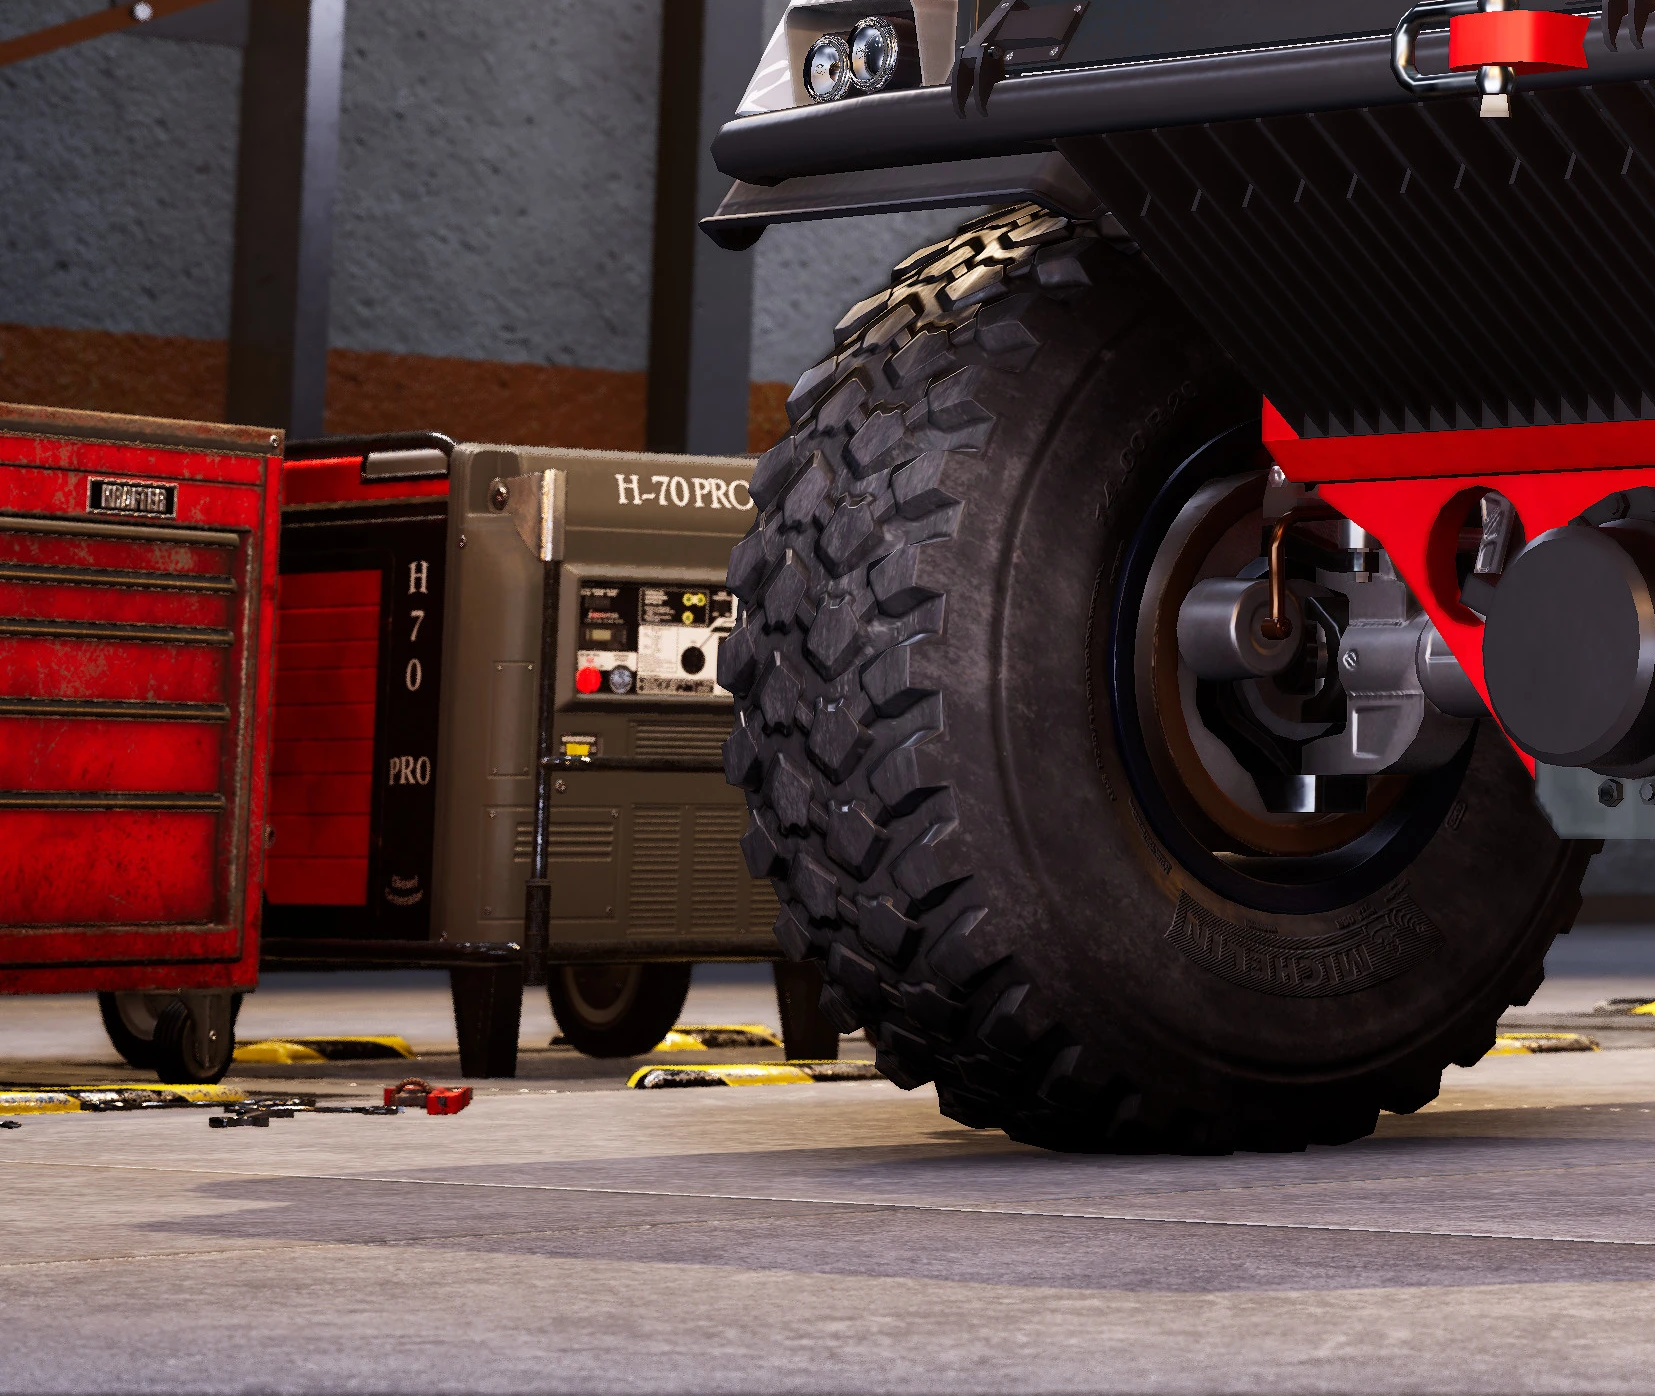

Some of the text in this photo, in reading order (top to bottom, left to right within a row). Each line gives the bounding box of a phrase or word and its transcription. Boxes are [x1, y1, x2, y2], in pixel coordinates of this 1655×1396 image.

[614, 473, 754, 510] H-70 PRO
[388, 755, 431, 786] PRO
[1184, 911, 1375, 986] MICHELIN
